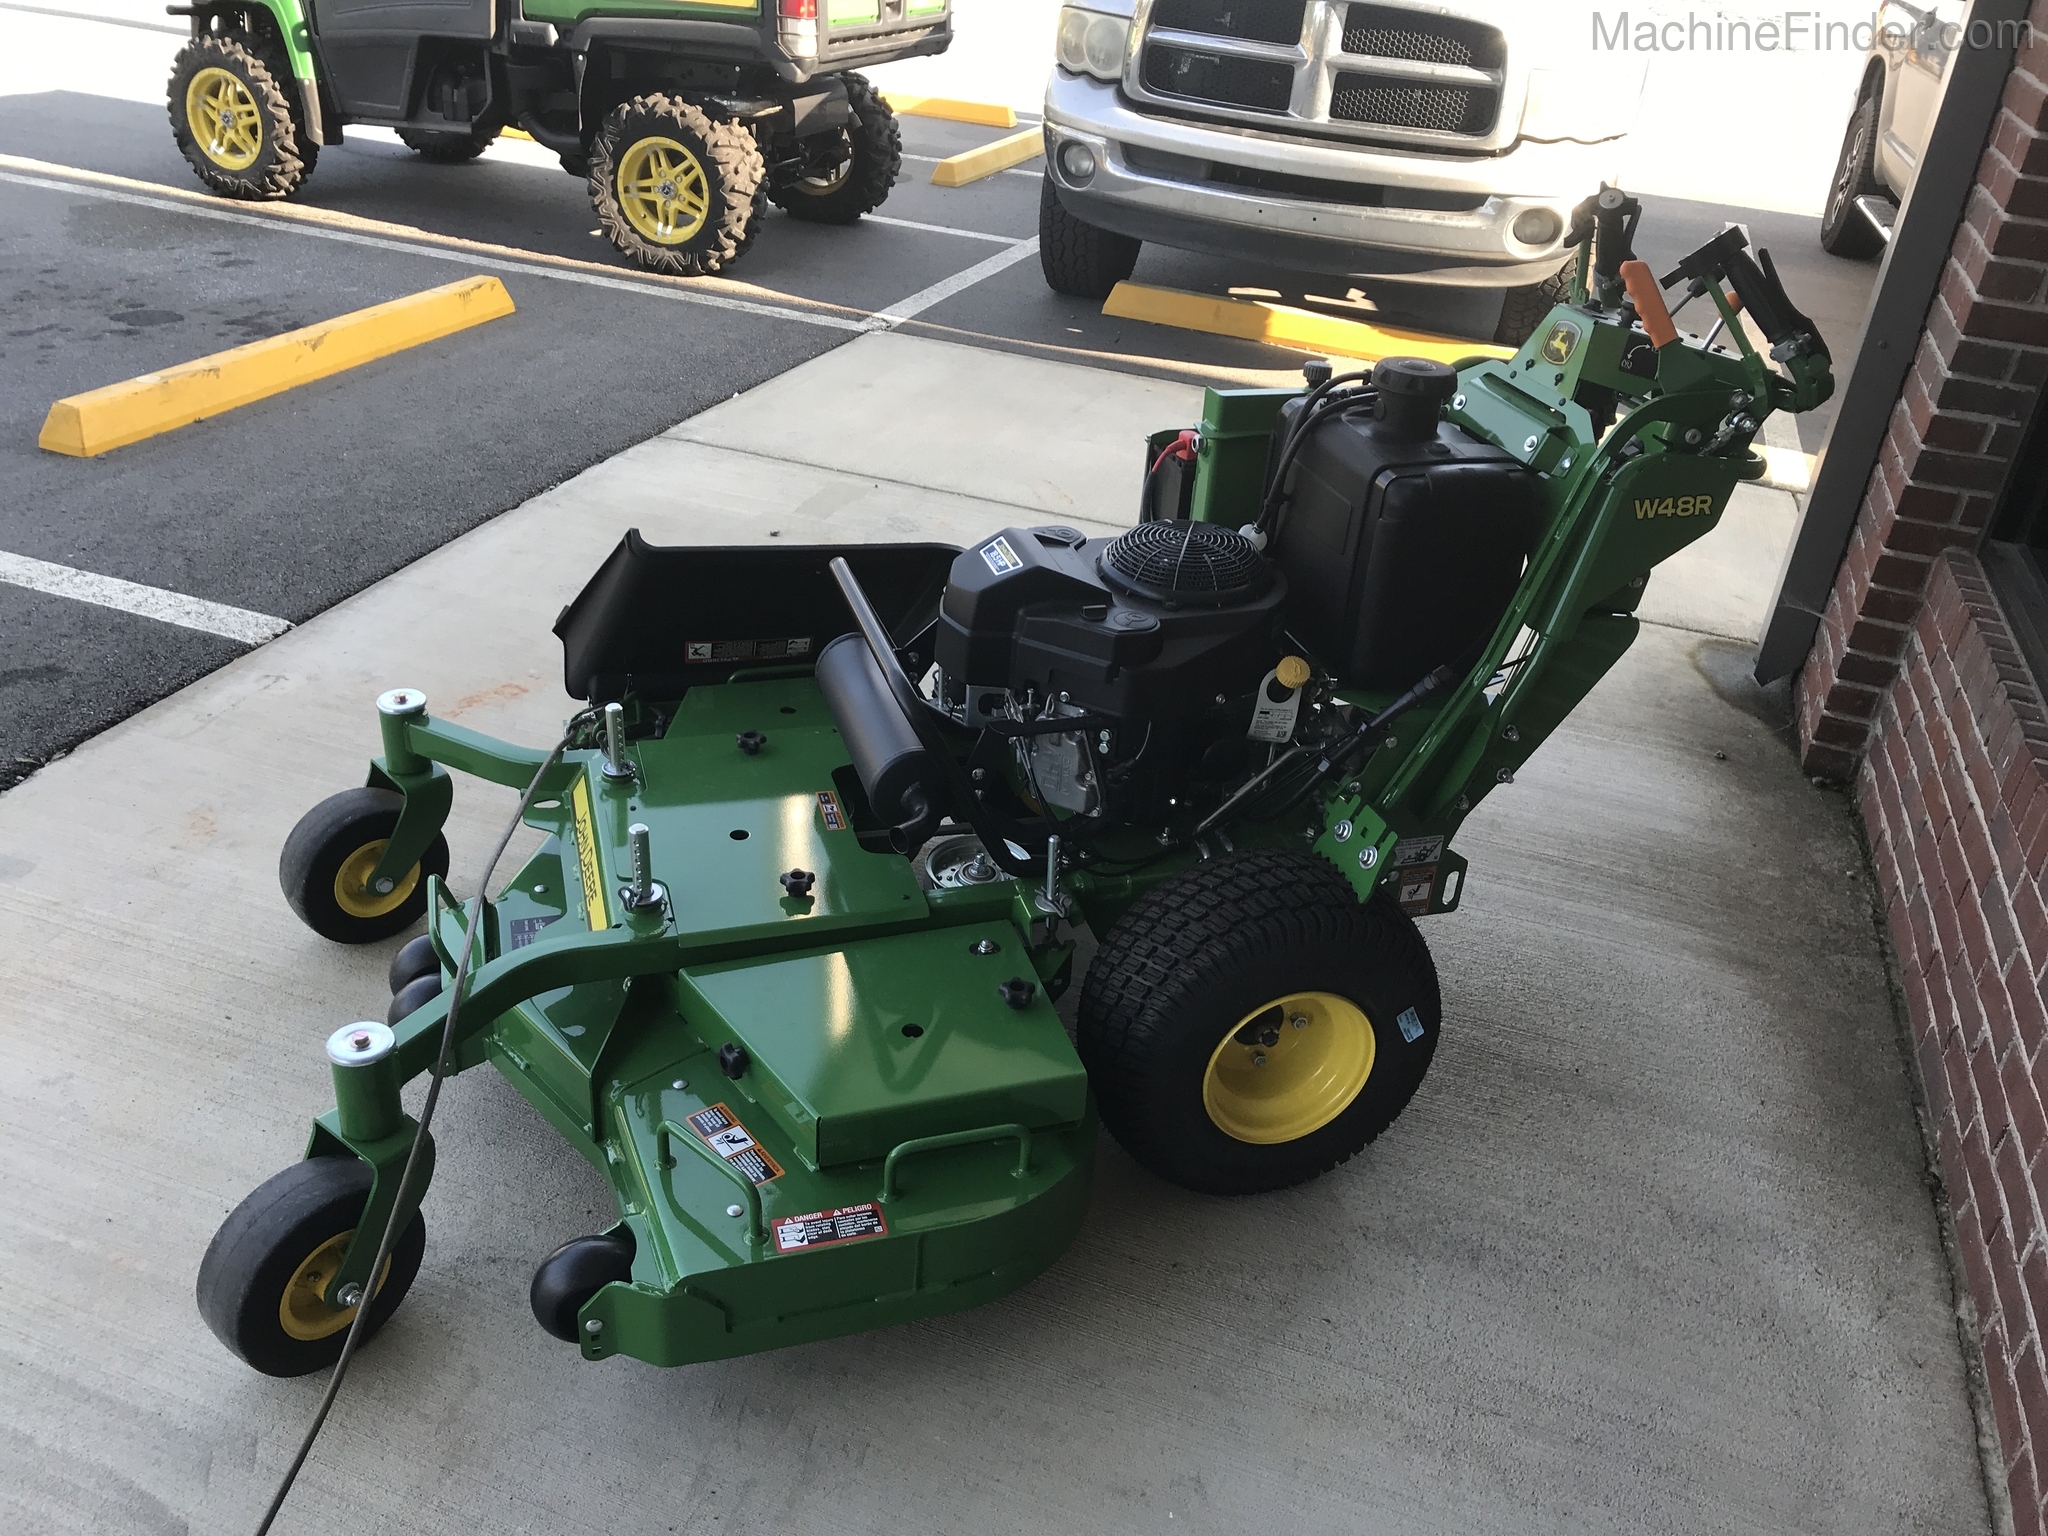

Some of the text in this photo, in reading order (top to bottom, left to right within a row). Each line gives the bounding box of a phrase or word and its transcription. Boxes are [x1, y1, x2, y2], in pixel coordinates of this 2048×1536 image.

[1634, 494, 1713, 520] W48R
[576, 810, 598, 907] JOHN DEERE
[794, 1212, 823, 1222] DANGER
[842, 1203, 872, 1214] PELIGRO
